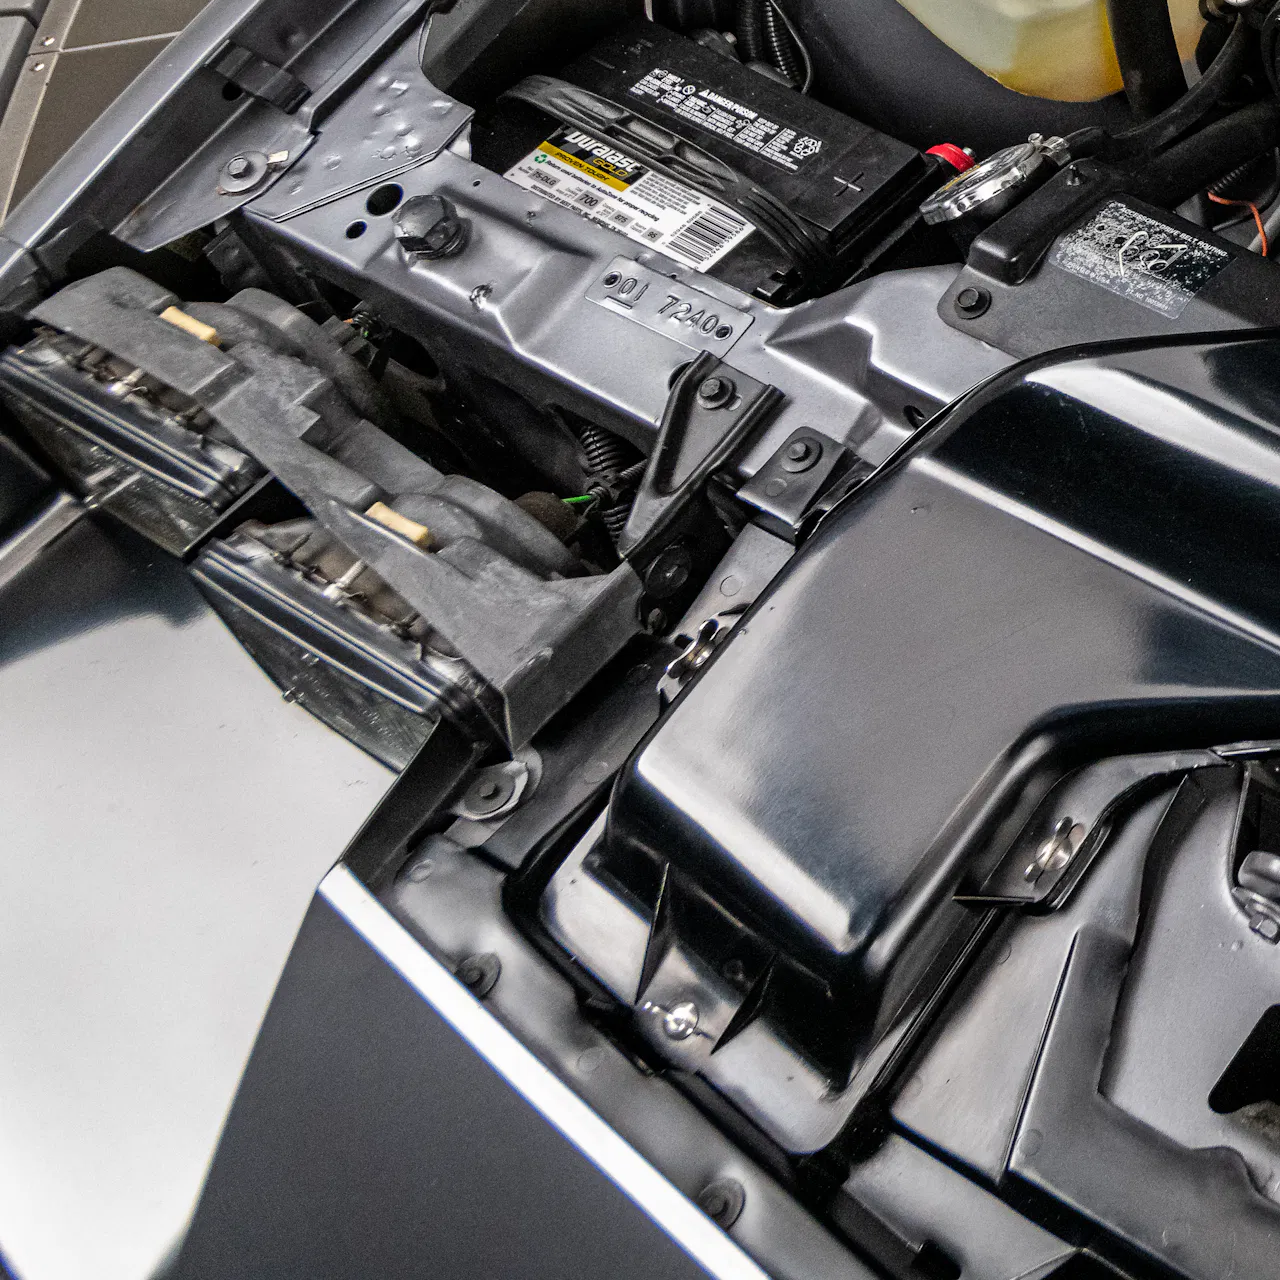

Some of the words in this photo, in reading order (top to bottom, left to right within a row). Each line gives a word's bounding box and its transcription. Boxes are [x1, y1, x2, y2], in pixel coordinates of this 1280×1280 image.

[554, 151, 585, 172] PROVEN
[584, 164, 610, 181] TOUGH
[592, 157, 629, 178] GOLD
[531, 170, 557, 187] 75-DLG
[578, 193, 600, 208] 700
[596, 185, 618, 200] AutoZone
[623, 199, 640, 212] proper
[638, 208, 660, 222] recycling
